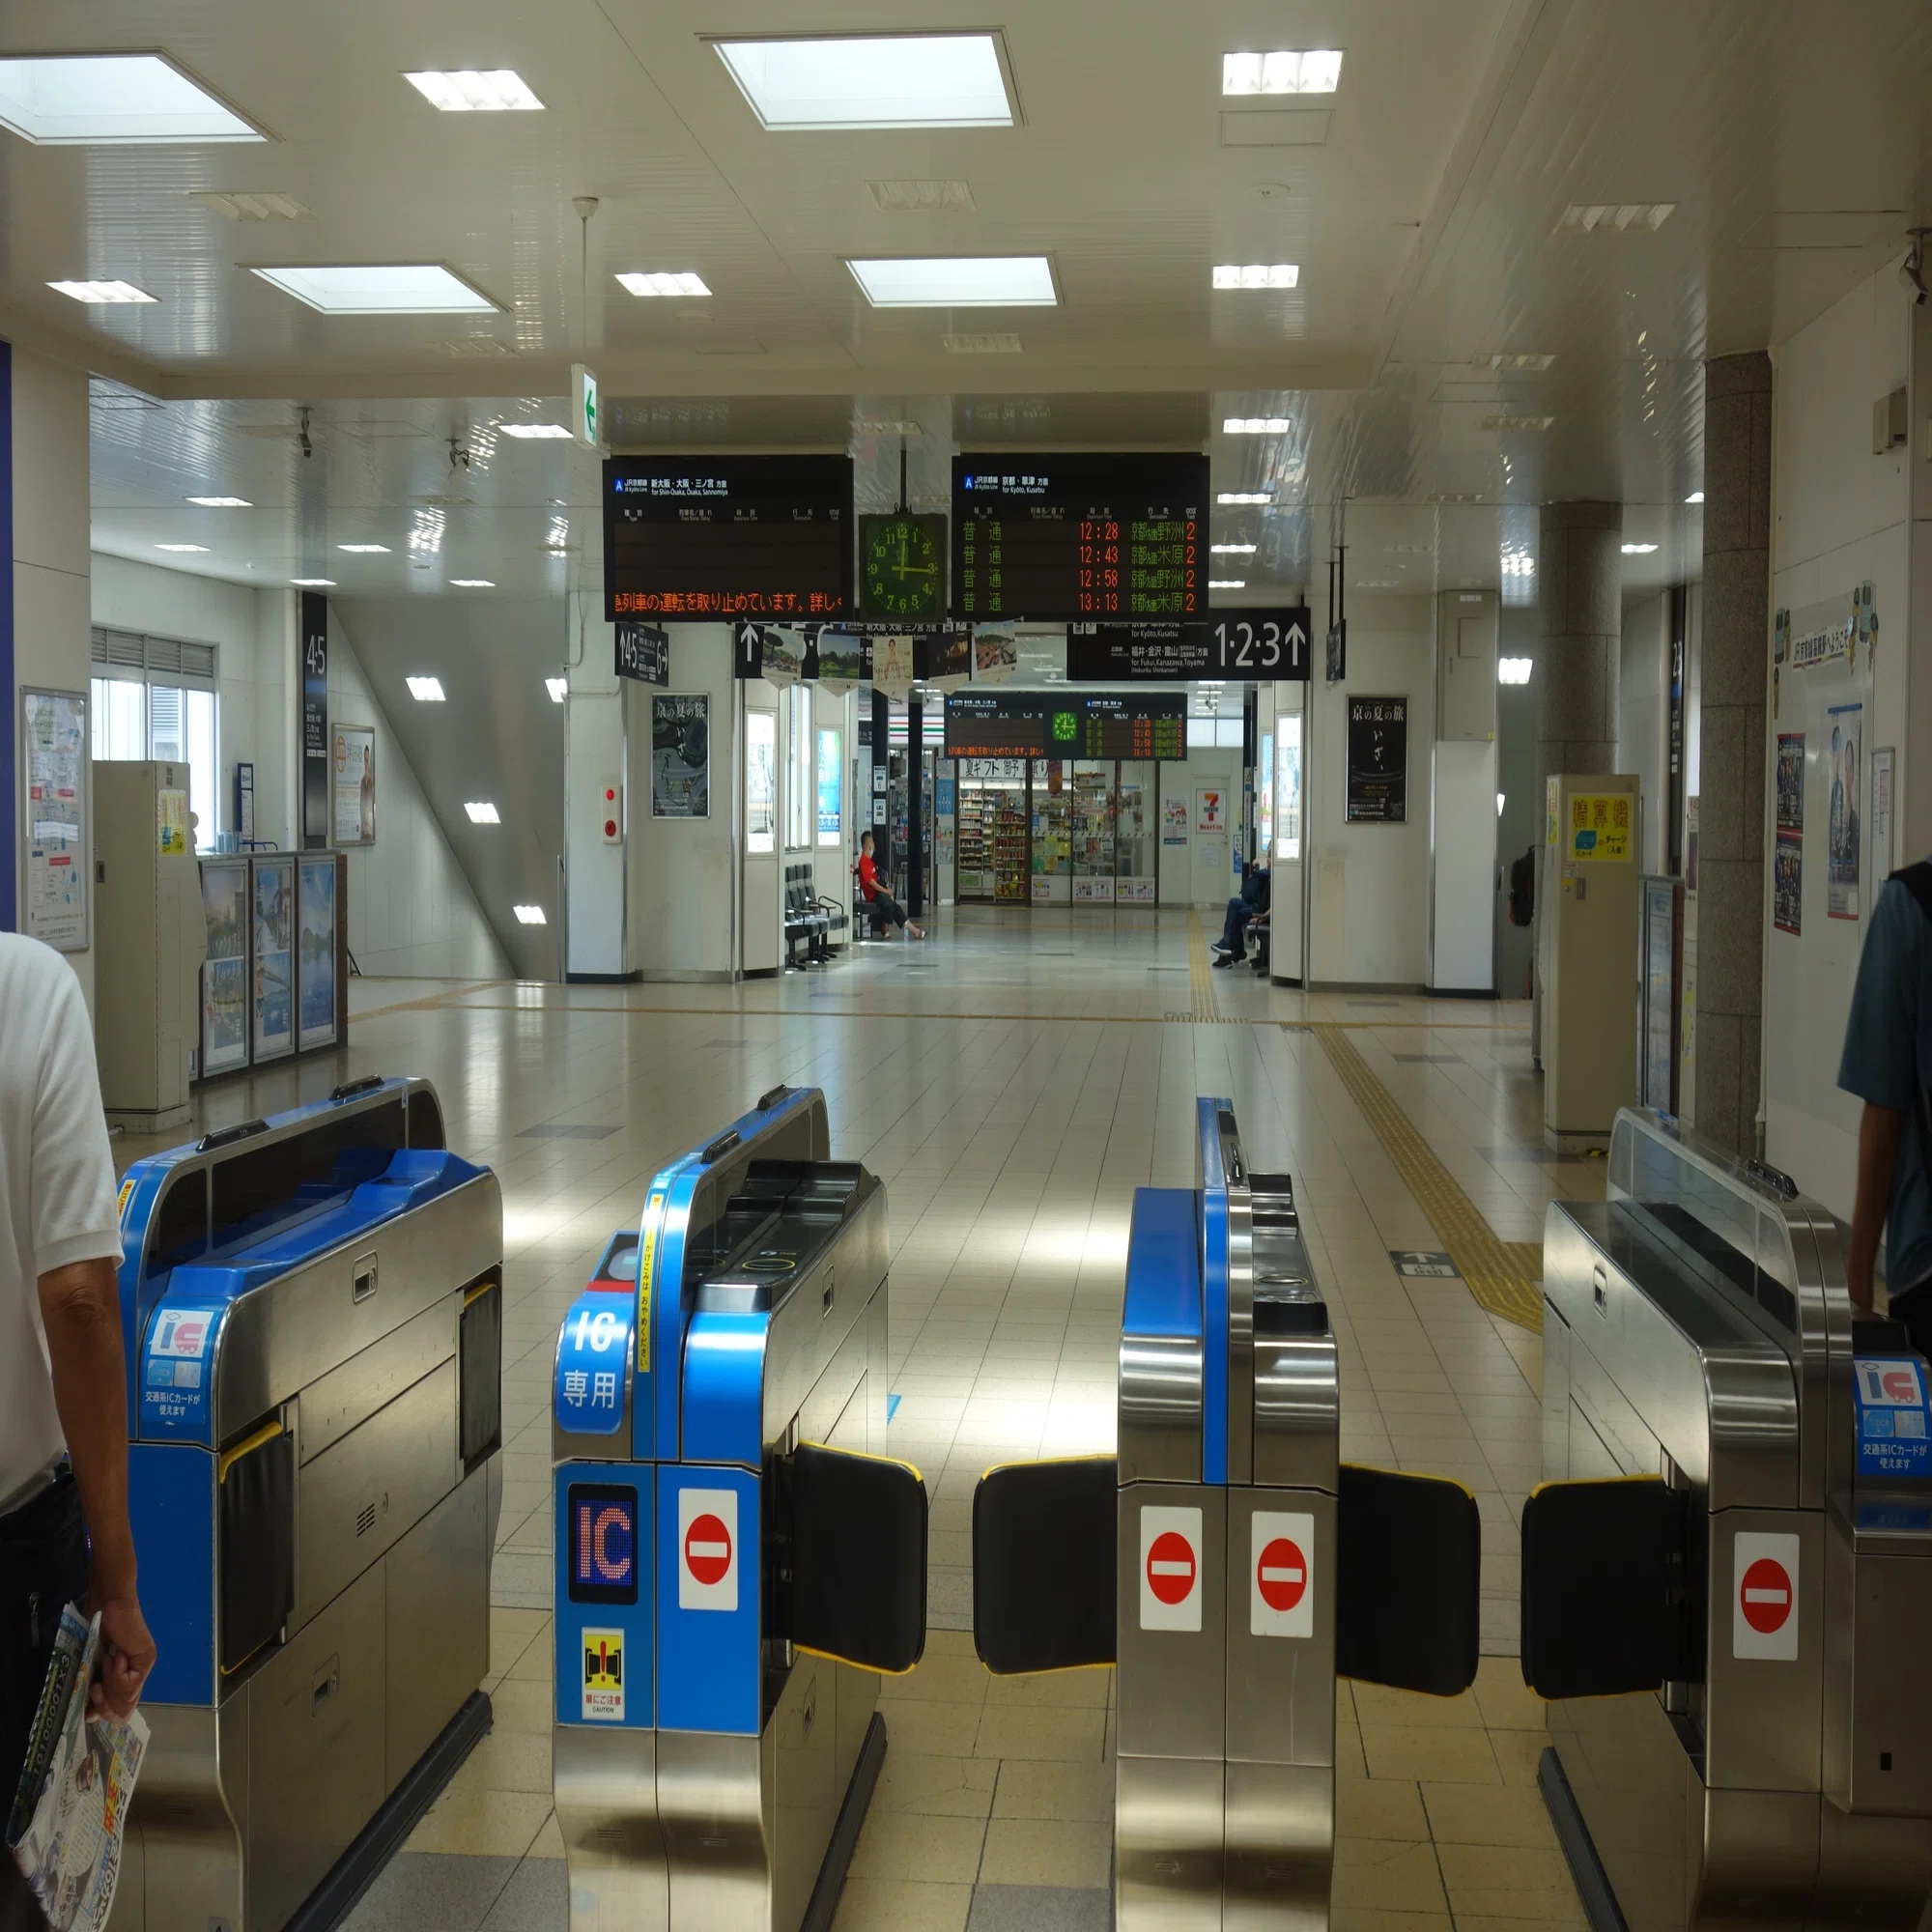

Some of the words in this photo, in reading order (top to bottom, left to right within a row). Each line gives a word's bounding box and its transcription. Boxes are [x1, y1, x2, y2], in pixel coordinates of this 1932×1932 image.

[615, 480, 623, 492] A
[897, 527, 908, 539] 12
[912, 531, 918, 543] 1
[1079, 523, 1119, 540] 12:28
[1186, 523, 1195, 540] 2
[886, 533, 896, 544] 11
[875, 546, 886, 557] 10
[923, 543, 930, 554] 2
[1079, 546, 1119, 563] 12:43
[1186, 546, 1195, 563] 2
[870, 563, 878, 575] 9
[928, 562, 935, 575] 3
[1079, 569, 1119, 586] 12:58
[1186, 569, 1195, 586] 2
[875, 582, 883, 595] 8
[923, 582, 929, 594] 4
[887, 595, 895, 607] 7
[899, 598, 906, 611] 6
[911, 594, 919, 606] 5
[1079, 593, 1119, 611] 13:13
[1186, 593, 1195, 611] 2
[1131, 629, 1140, 638] for
[657, 639, 662, 675] 6
[1352, 704, 1404, 722] 京の夏の旅
[563, 1369, 616, 1409] 専用
[145, 1391, 201, 1406] 交通系ICカードが
[159, 1405, 186, 1417] 使えます
[1862, 1443, 1928, 1457] 交通系ICカードが
[1879, 1457, 1912, 1470] 使えます
[580, 1507, 631, 1579] IC
[592, 1705, 614, 1715] CAUTION
